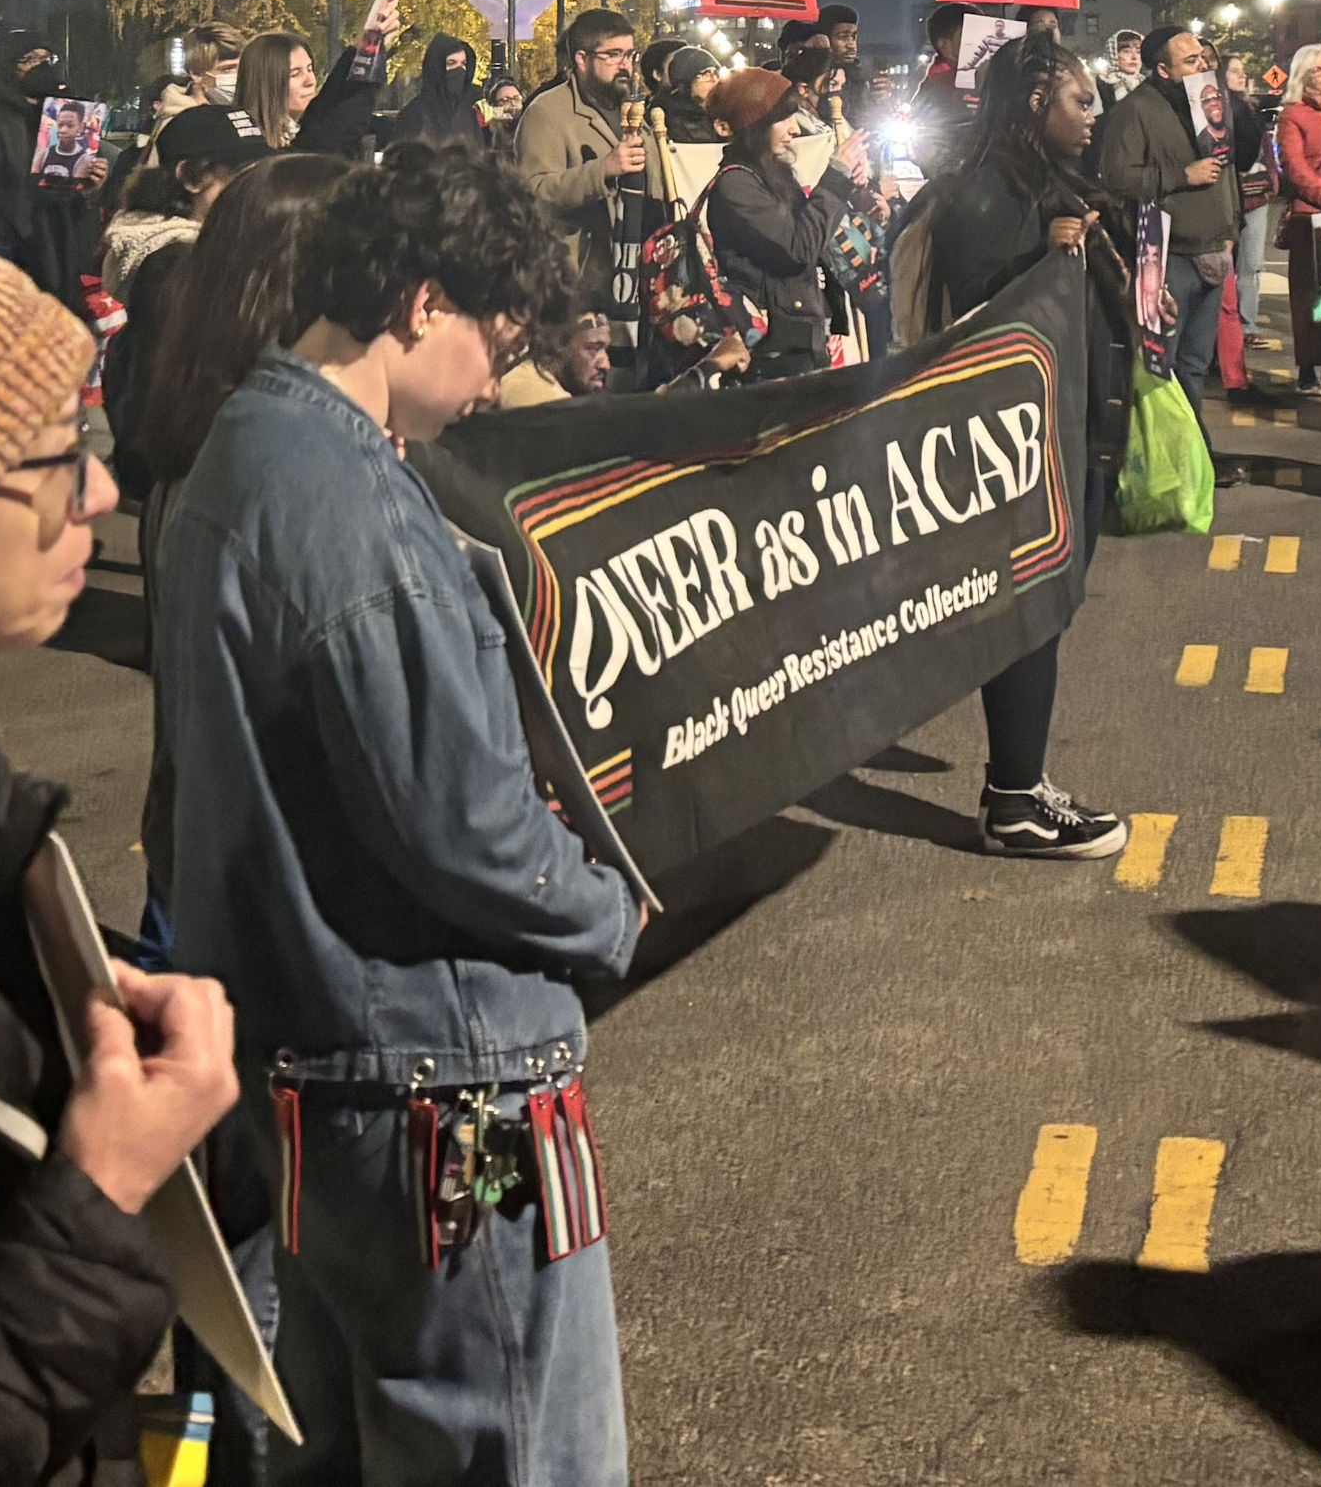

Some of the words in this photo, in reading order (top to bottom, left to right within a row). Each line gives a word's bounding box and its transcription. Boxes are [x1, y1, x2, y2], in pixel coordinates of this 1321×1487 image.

[569, 508, 754, 730] QUEER
[755, 510, 820, 601] as
[811, 465, 881, 566] in
[886, 401, 1042, 546] ACAB
[662, 696, 730, 770] Black
[731, 667, 787, 736] Queer
[783, 613, 900, 694] Resistance
[899, 567, 999, 634] Collective
